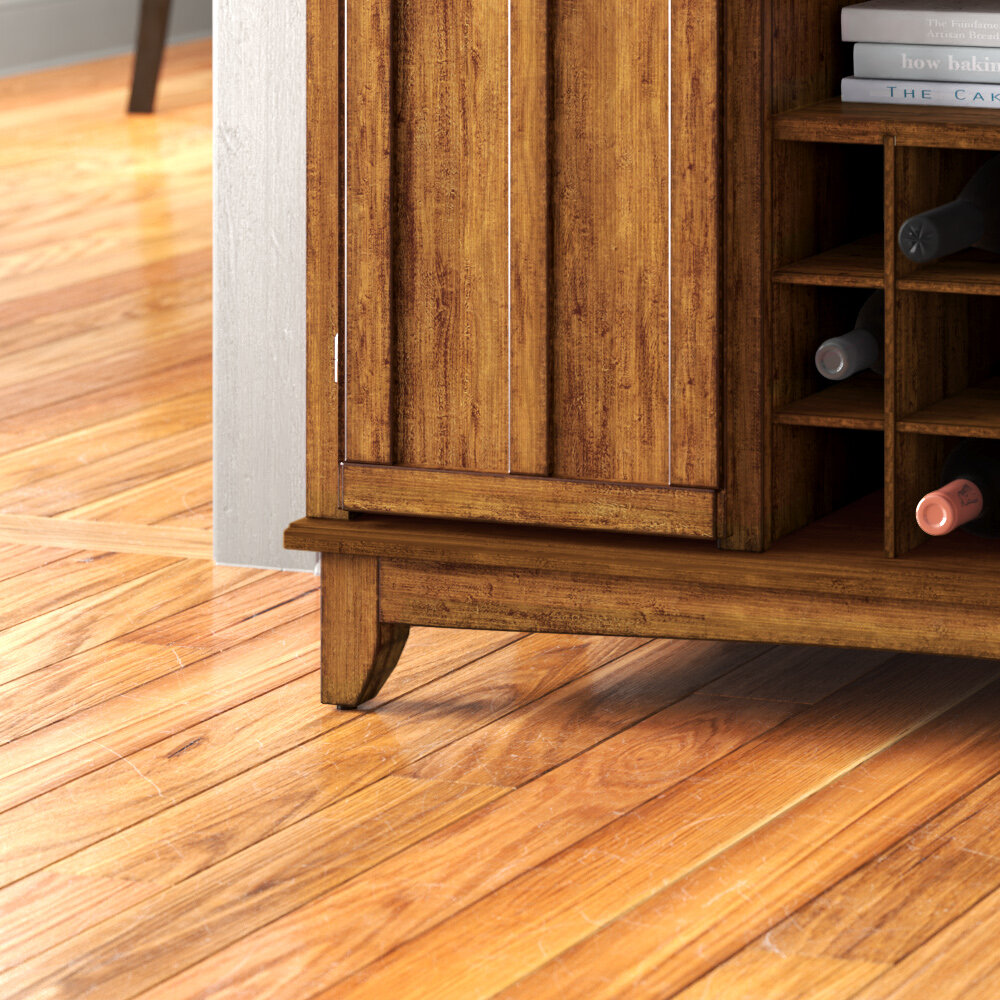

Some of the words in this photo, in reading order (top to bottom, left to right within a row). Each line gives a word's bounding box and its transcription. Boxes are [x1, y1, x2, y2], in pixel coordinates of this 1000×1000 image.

[927, 18, 946, 28] The
[927, 29, 965, 40] Artisan
[969, 31, 1000, 41] Bread
[901, 53, 941, 70] how
[886, 86, 932, 99] THE
